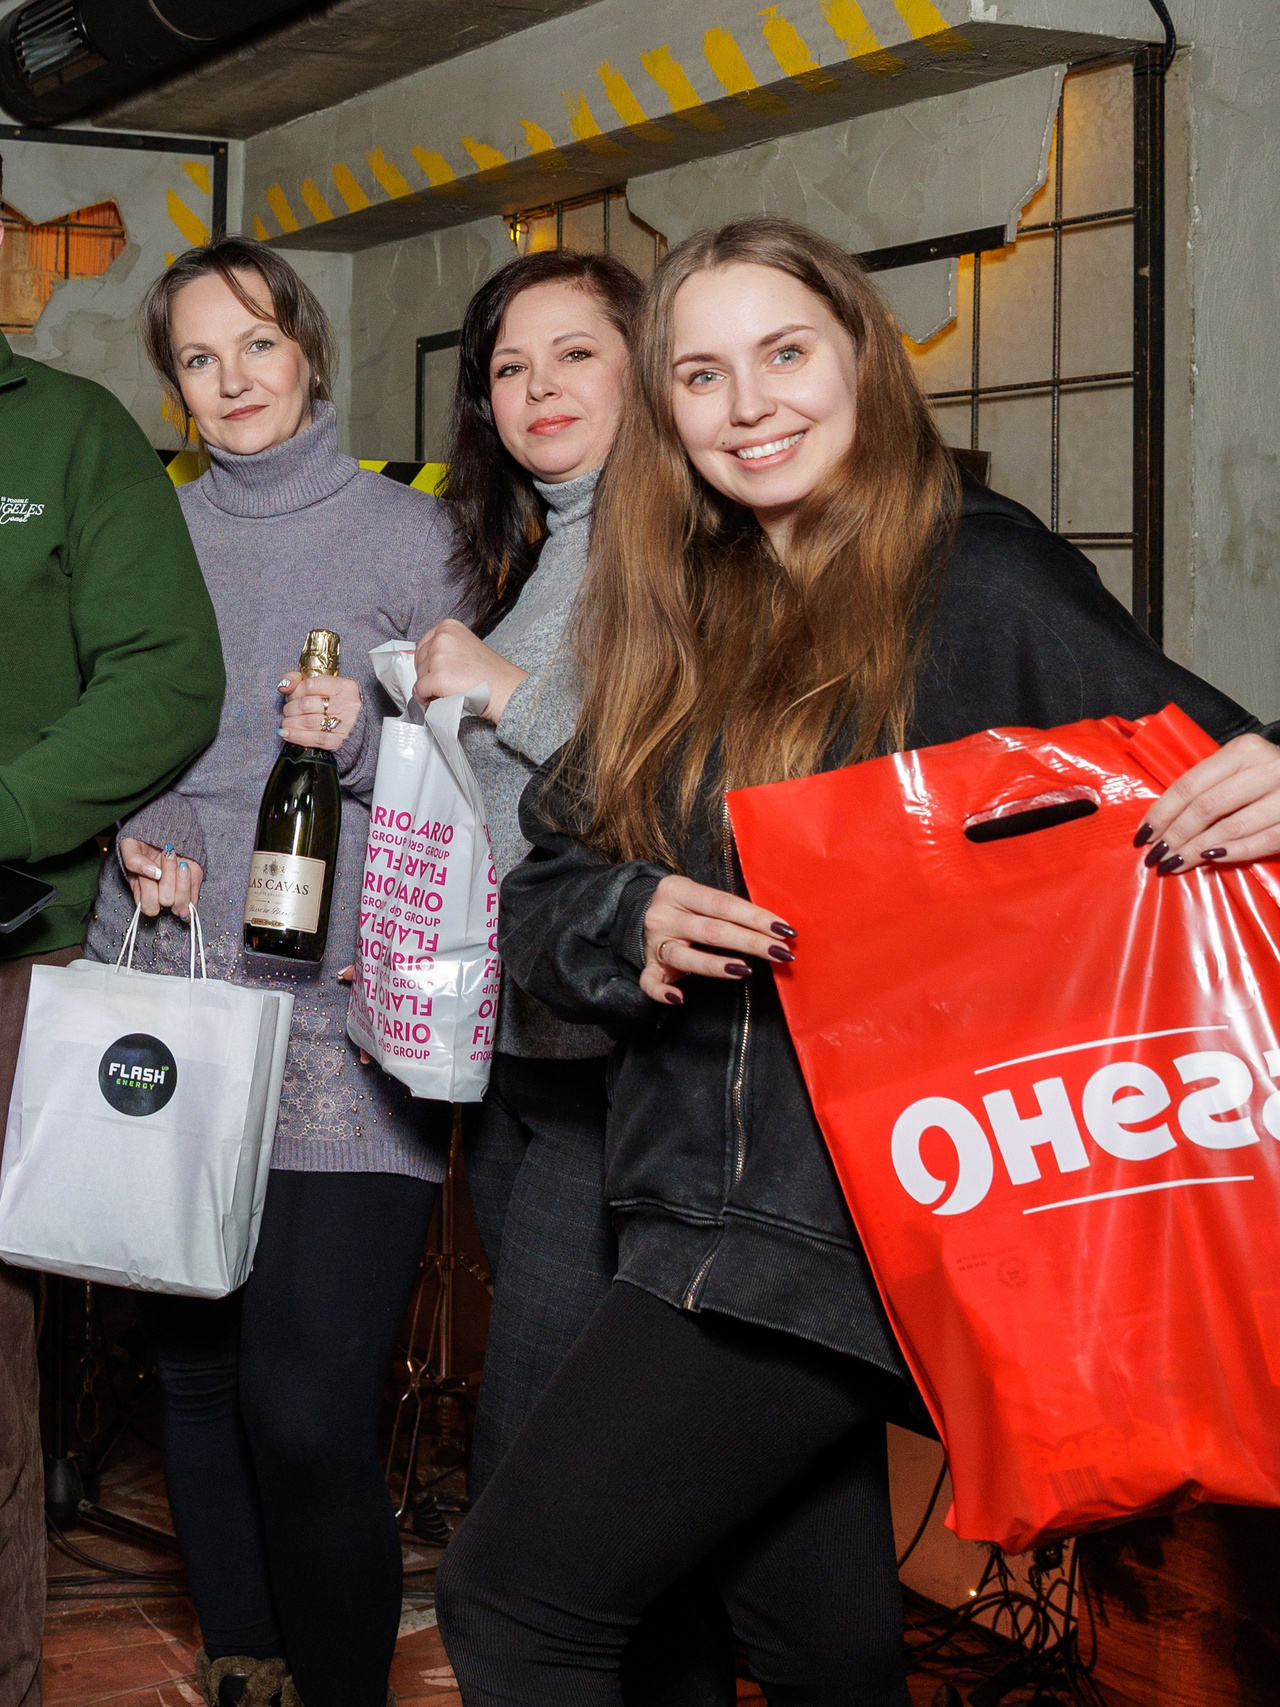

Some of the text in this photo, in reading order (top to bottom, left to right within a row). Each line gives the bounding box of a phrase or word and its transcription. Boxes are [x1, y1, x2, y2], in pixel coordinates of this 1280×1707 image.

[265, 879, 309, 895] CAVAS
[404, 911, 441, 927] GROUP
[393, 1045, 431, 1060] GROUP
[108, 1062, 165, 1084] FLASH
[116, 1078, 154, 1090] ENERGY
